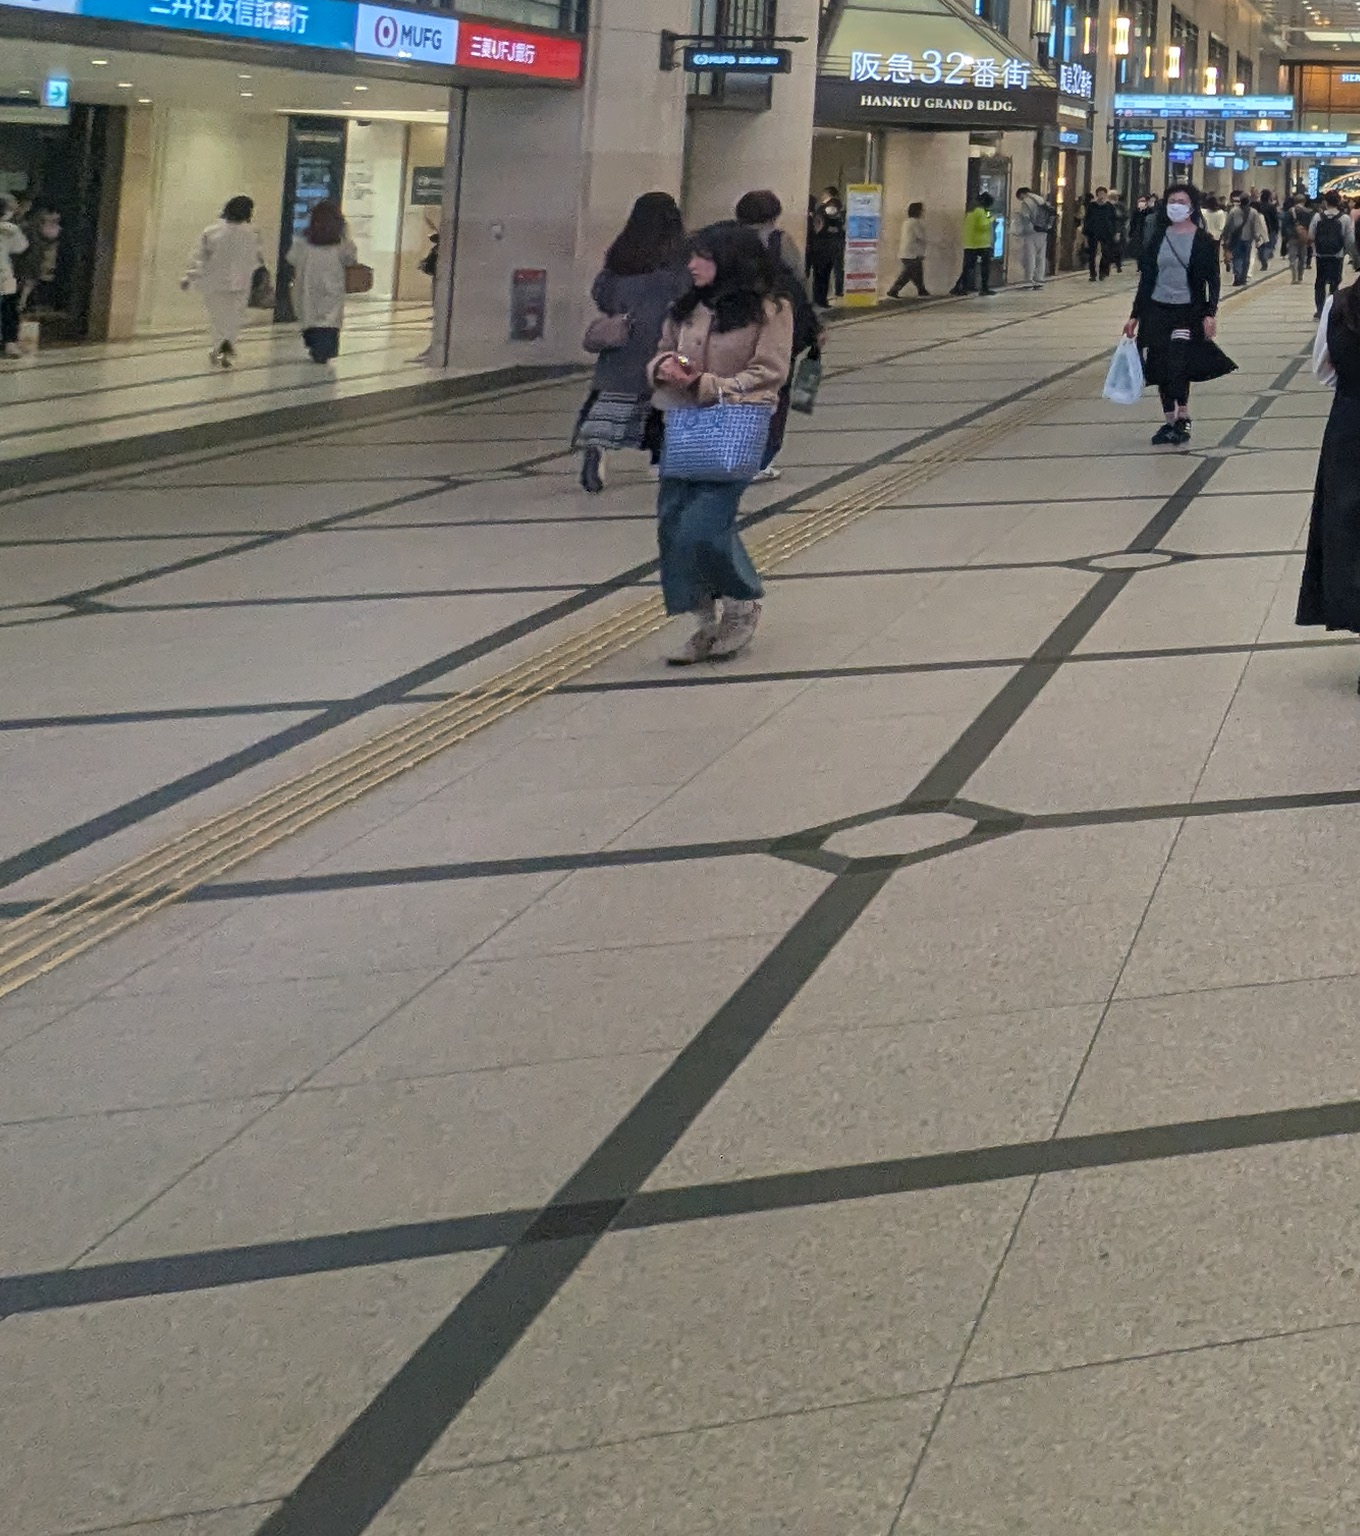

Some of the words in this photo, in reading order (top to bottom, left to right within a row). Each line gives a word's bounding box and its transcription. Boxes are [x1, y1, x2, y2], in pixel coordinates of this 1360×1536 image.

[401, 24, 442, 51] MUFG
[470, 36, 536, 64] 三菱UFJ銀行
[850, 50, 1030, 90] 阪急32番街
[861, 95, 921, 109] HANKYU
[924, 98, 974, 111] GRAND
[976, 100, 1017, 113] BLDG.
